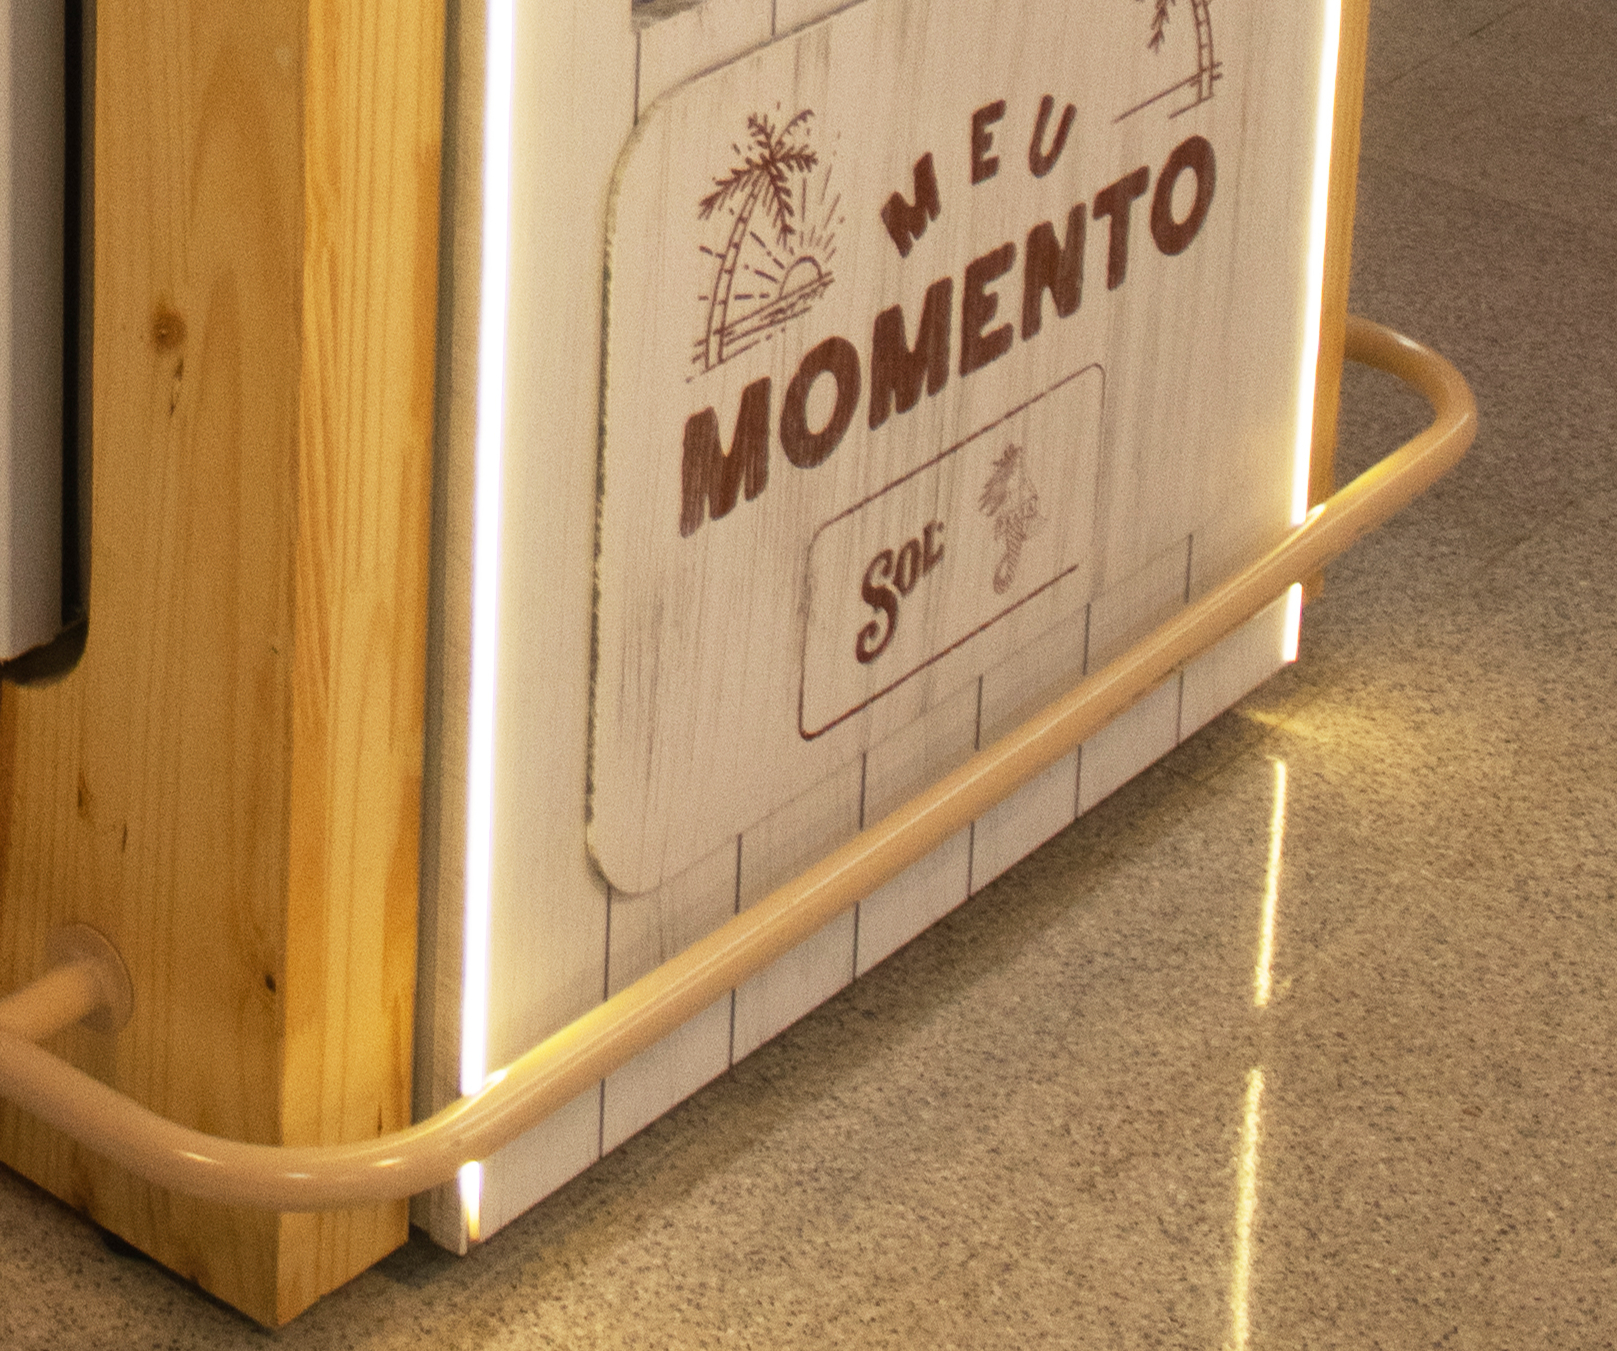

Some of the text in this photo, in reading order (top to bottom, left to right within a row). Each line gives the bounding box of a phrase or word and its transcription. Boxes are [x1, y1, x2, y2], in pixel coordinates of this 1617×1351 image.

[881, 94, 1076, 258] MEU
[679, 135, 1217, 540] MOMENTO
[855, 520, 946, 665] SOL
